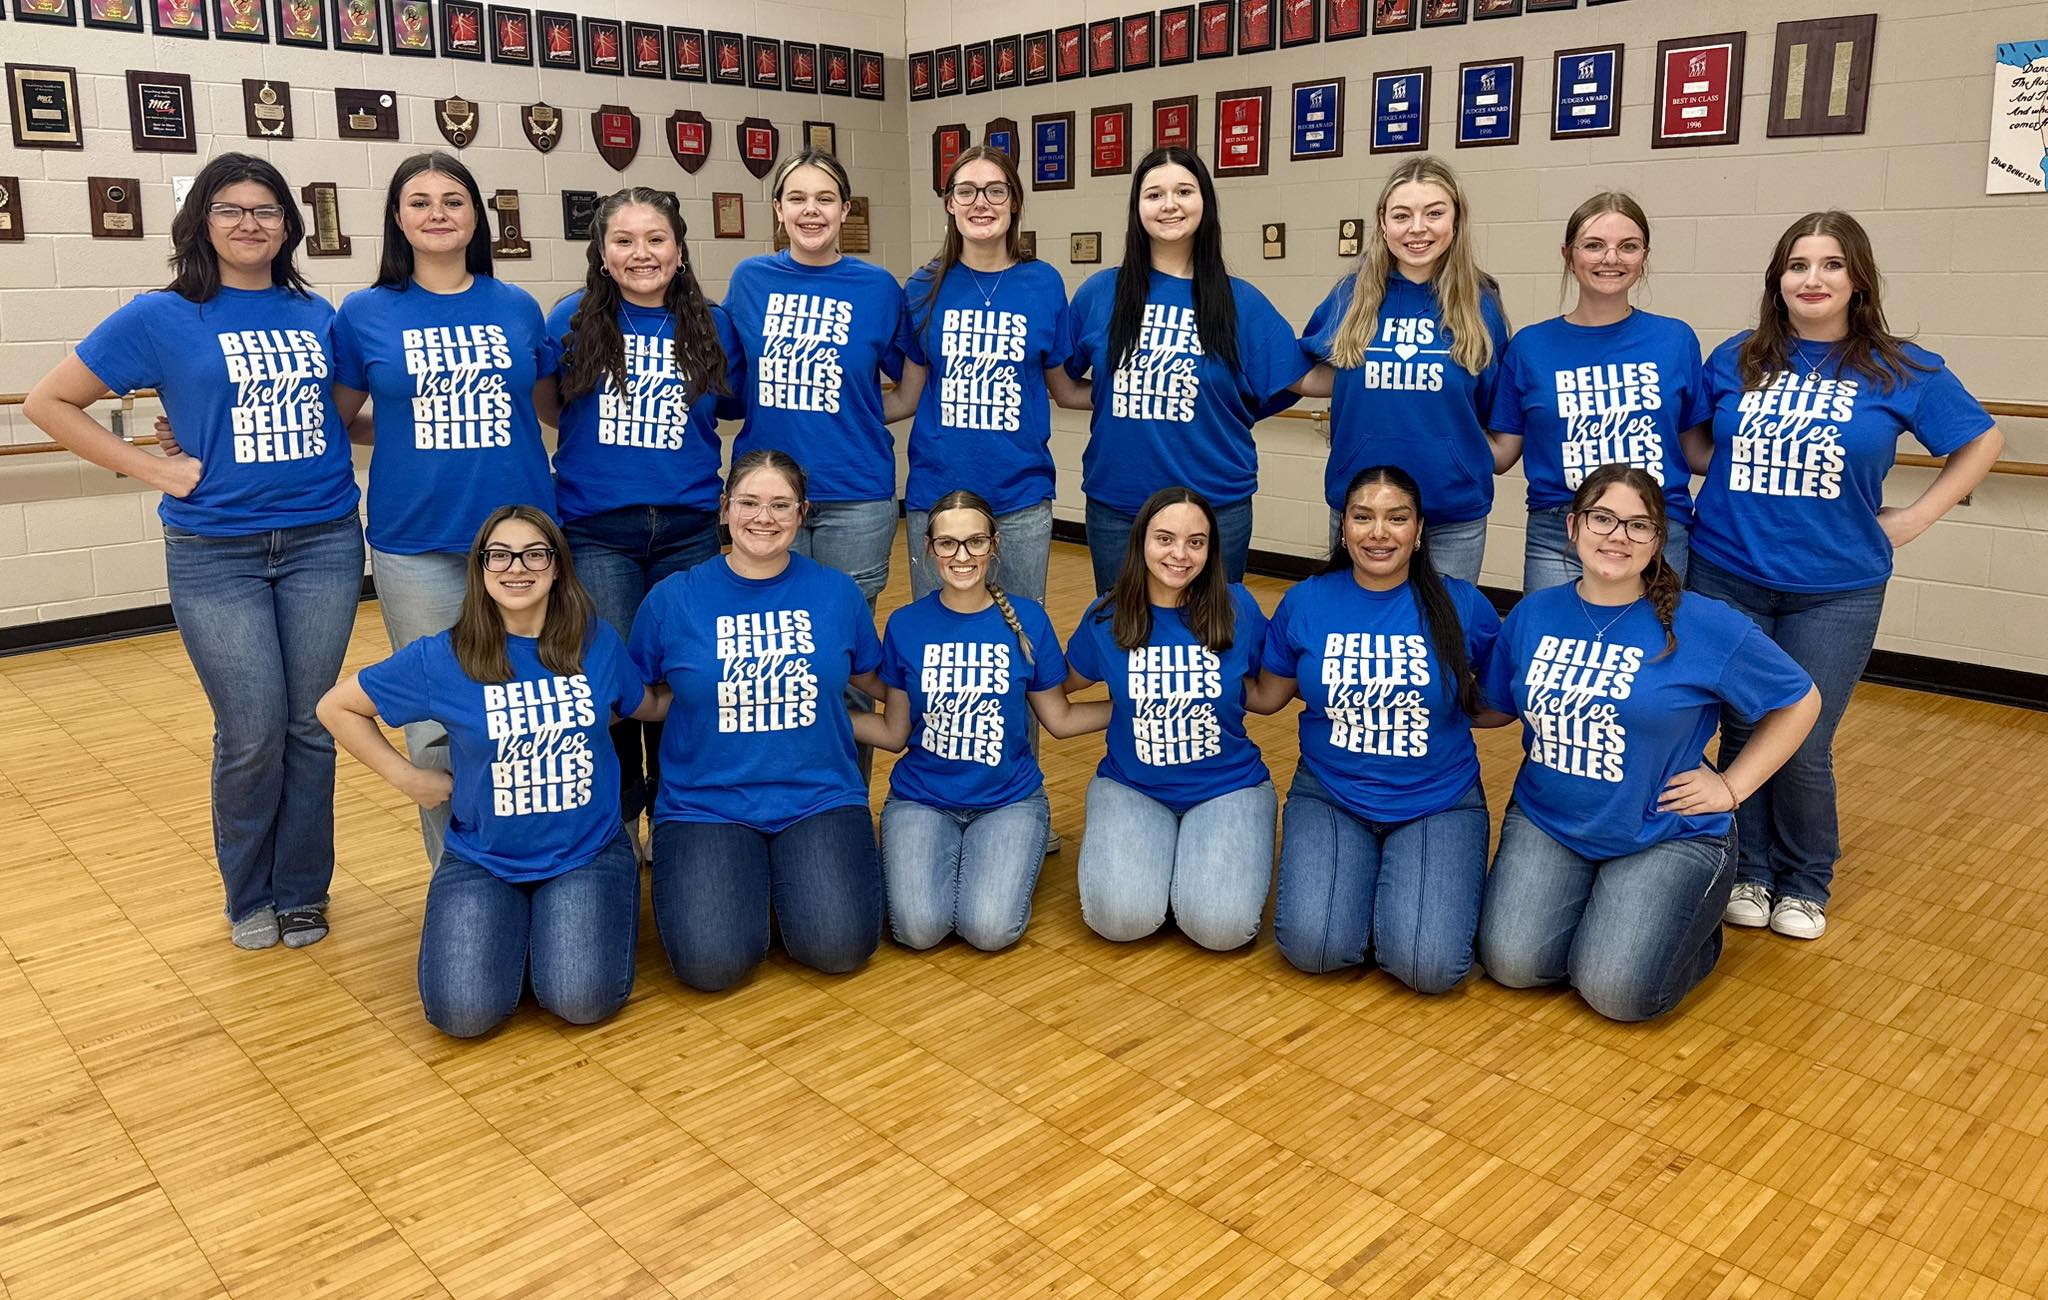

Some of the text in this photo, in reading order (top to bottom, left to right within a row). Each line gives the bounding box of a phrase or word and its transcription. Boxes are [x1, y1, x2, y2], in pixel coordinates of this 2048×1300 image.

[148, 98, 171, 110] ma
[1465, 107, 1486, 115] JUDGES
[1585, 94, 1609, 102] AWARD
[1672, 97, 1688, 105] BEST
[1698, 94, 1719, 103] CLASS
[2007, 106, 2032, 116] And
[2009, 92, 2036, 102] And
[1577, 118, 1592, 126] 1996
[1686, 121, 1702, 129] 1996
[766, 293, 853, 324] BELLES
[943, 309, 1027, 337] BELLES
[1141, 304, 1198, 332] ELLE
[218, 330, 322, 355] BELLES
[402, 325, 507, 349] BELLES
[762, 315, 850, 345] BELLES
[1139, 327, 1205, 356] ELLES
[1382, 318, 1435, 345] FHS
[405, 345, 512, 375] BELLES
[622, 334, 676, 359] ELLE
[763, 333, 840, 364] Belles
[941, 332, 1026, 362] BELLES
[225, 352, 328, 383] BELLES
[416, 362, 506, 400] Belles
[624, 355, 691, 381] ELLE
[759, 357, 843, 390] BELLES
[945, 351, 1018, 383] Belles
[1365, 361, 1444, 392] BELLES
[1555, 362, 1660, 392] BELLES
[237, 370, 321, 409] Belles
[759, 381, 840, 414] BELLES
[941, 377, 1021, 407] BELLES
[1113, 368, 1200, 399] BELLES
[1759, 370, 1859, 397] ELLES
[411, 392, 512, 421] BELLES
[599, 394, 690, 426] BELLES
[1112, 393, 1195, 423] BELLES
[1557, 384, 1662, 418] BELLES
[1737, 390, 1854, 422] BELLES
[231, 401, 325, 434] BELLES
[941, 402, 1020, 432] BELLES
[1567, 404, 1656, 443] Belles
[1738, 410, 1842, 446] Belles
[234, 428, 327, 463] BELLES
[415, 419, 511, 449] BELLES
[598, 420, 685, 450] BELLES
[1562, 434, 1663, 467] BELLES
[1732, 435, 1846, 473] BELLES
[1729, 463, 1842, 500] BELLES
[716, 609, 812, 639] BELLES
[717, 631, 816, 660] BELLES
[923, 642, 1010, 669] BELLES
[1128, 645, 1221, 672] BELLES
[1324, 632, 1428, 659] BELLES
[1533, 635, 1644, 673] BELLES
[723, 648, 812, 685] Belles
[921, 667, 1010, 695] BELLES
[1321, 657, 1430, 686] BELLES
[1525, 659, 1635, 700] BELLES
[484, 674, 592, 711] BELLES
[717, 674, 819, 707] BELLES
[1128, 671, 1223, 699] BELLES
[1328, 676, 1424, 711] Belles
[718, 700, 817, 733] BELLES
[927, 685, 1002, 718] Belles
[1135, 691, 1216, 722] Belles
[1527, 683, 1620, 726] Belles
[486, 698, 596, 740] BELLES
[922, 712, 1005, 741] BELLES
[1132, 716, 1222, 744] BELLES
[1324, 706, 1430, 731] BELLES
[497, 722, 588, 767] Belles
[921, 726, 1003, 767] BELLES
[1135, 736, 1222, 767] BELLES
[1329, 719, 1429, 758] BELLES
[491, 750, 594, 788] BELLES
[1530, 737, 1624, 783] BELLES
[493, 778, 592, 817] BELLES
